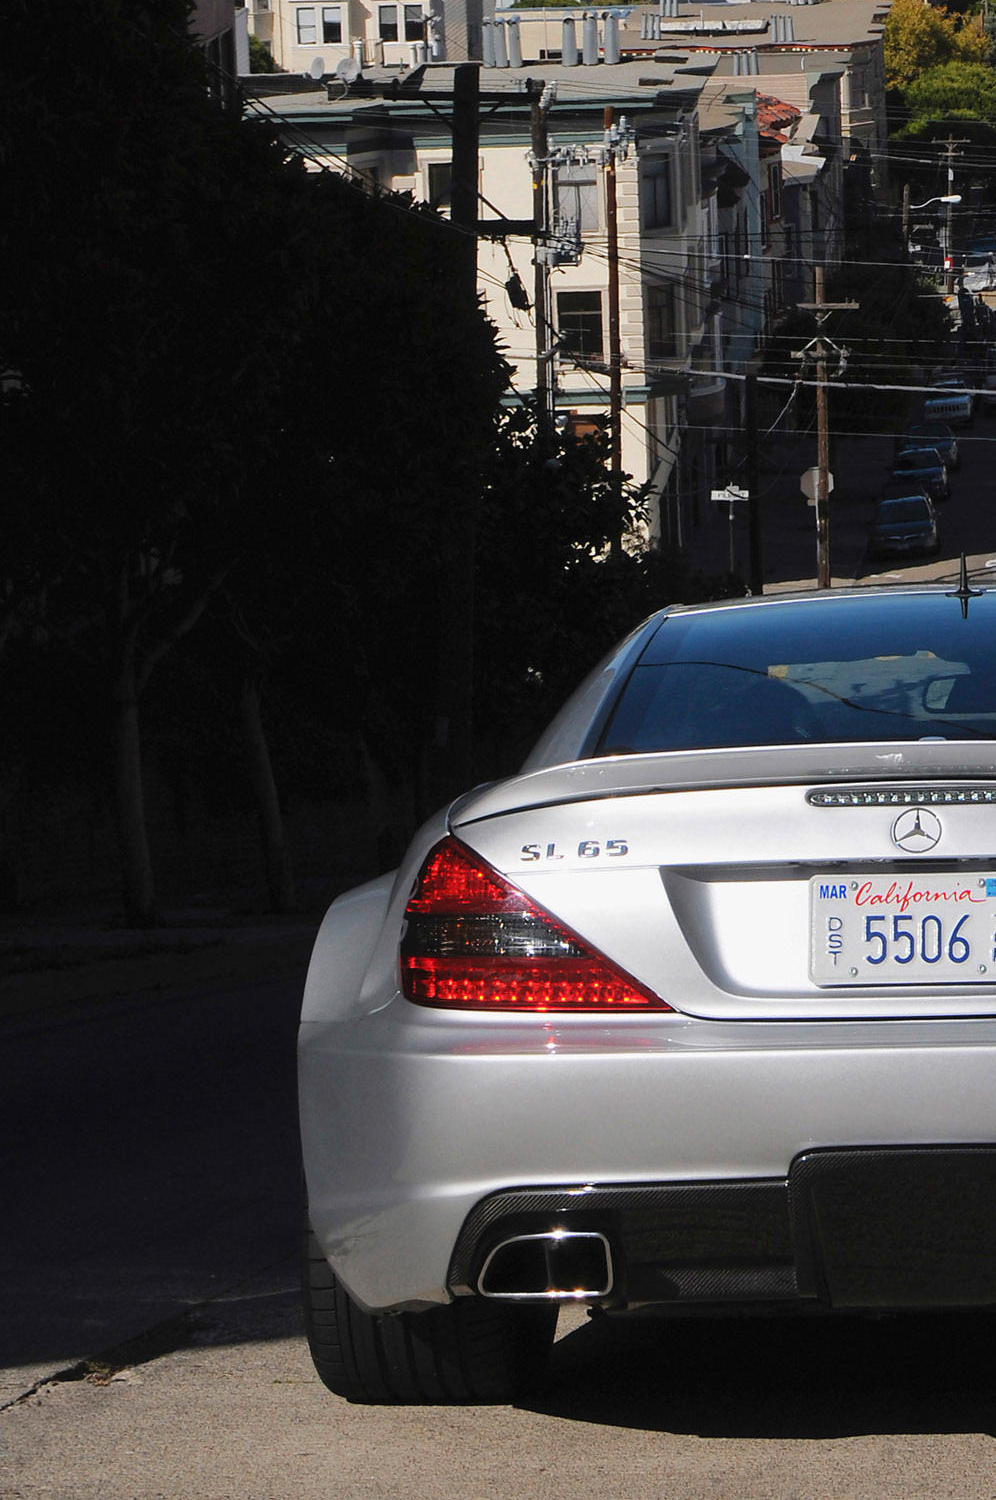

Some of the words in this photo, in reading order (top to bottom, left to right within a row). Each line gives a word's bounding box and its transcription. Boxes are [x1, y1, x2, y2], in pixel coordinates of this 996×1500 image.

[520, 843, 564, 861] SL
[577, 839, 629, 859] 65
[819, 884, 847, 899] MAR
[855, 881, 986, 912] California
[865, 914, 971, 965] 5506
